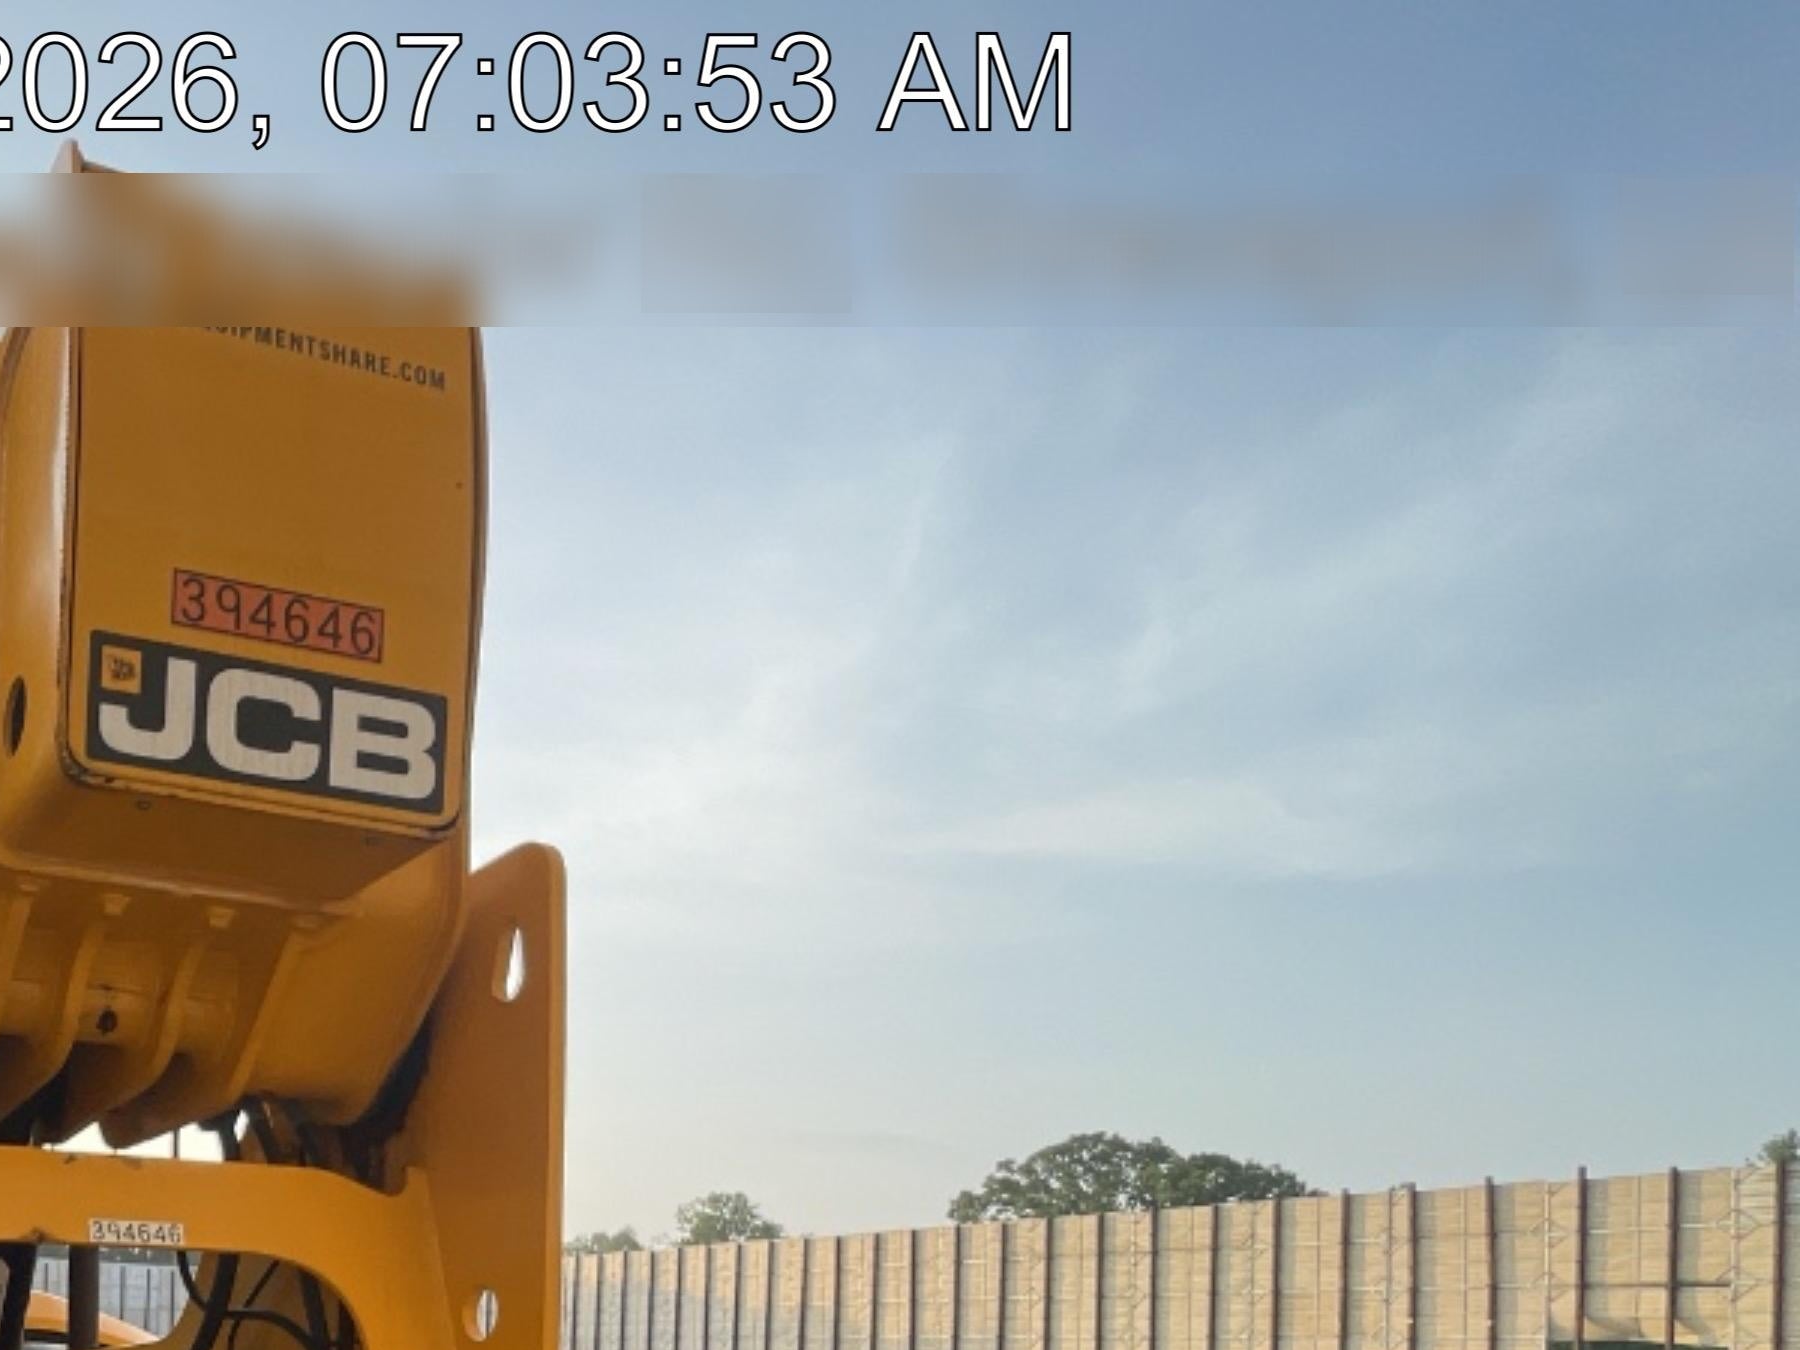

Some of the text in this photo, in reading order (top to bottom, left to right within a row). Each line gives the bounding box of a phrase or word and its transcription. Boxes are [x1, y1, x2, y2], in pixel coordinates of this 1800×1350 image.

[203, 327, 446, 391] IPMENTSHARE.COM
[181, 574, 377, 657] 394646
[99, 656, 439, 800] JCB
[92, 1219, 182, 1244] 394646
